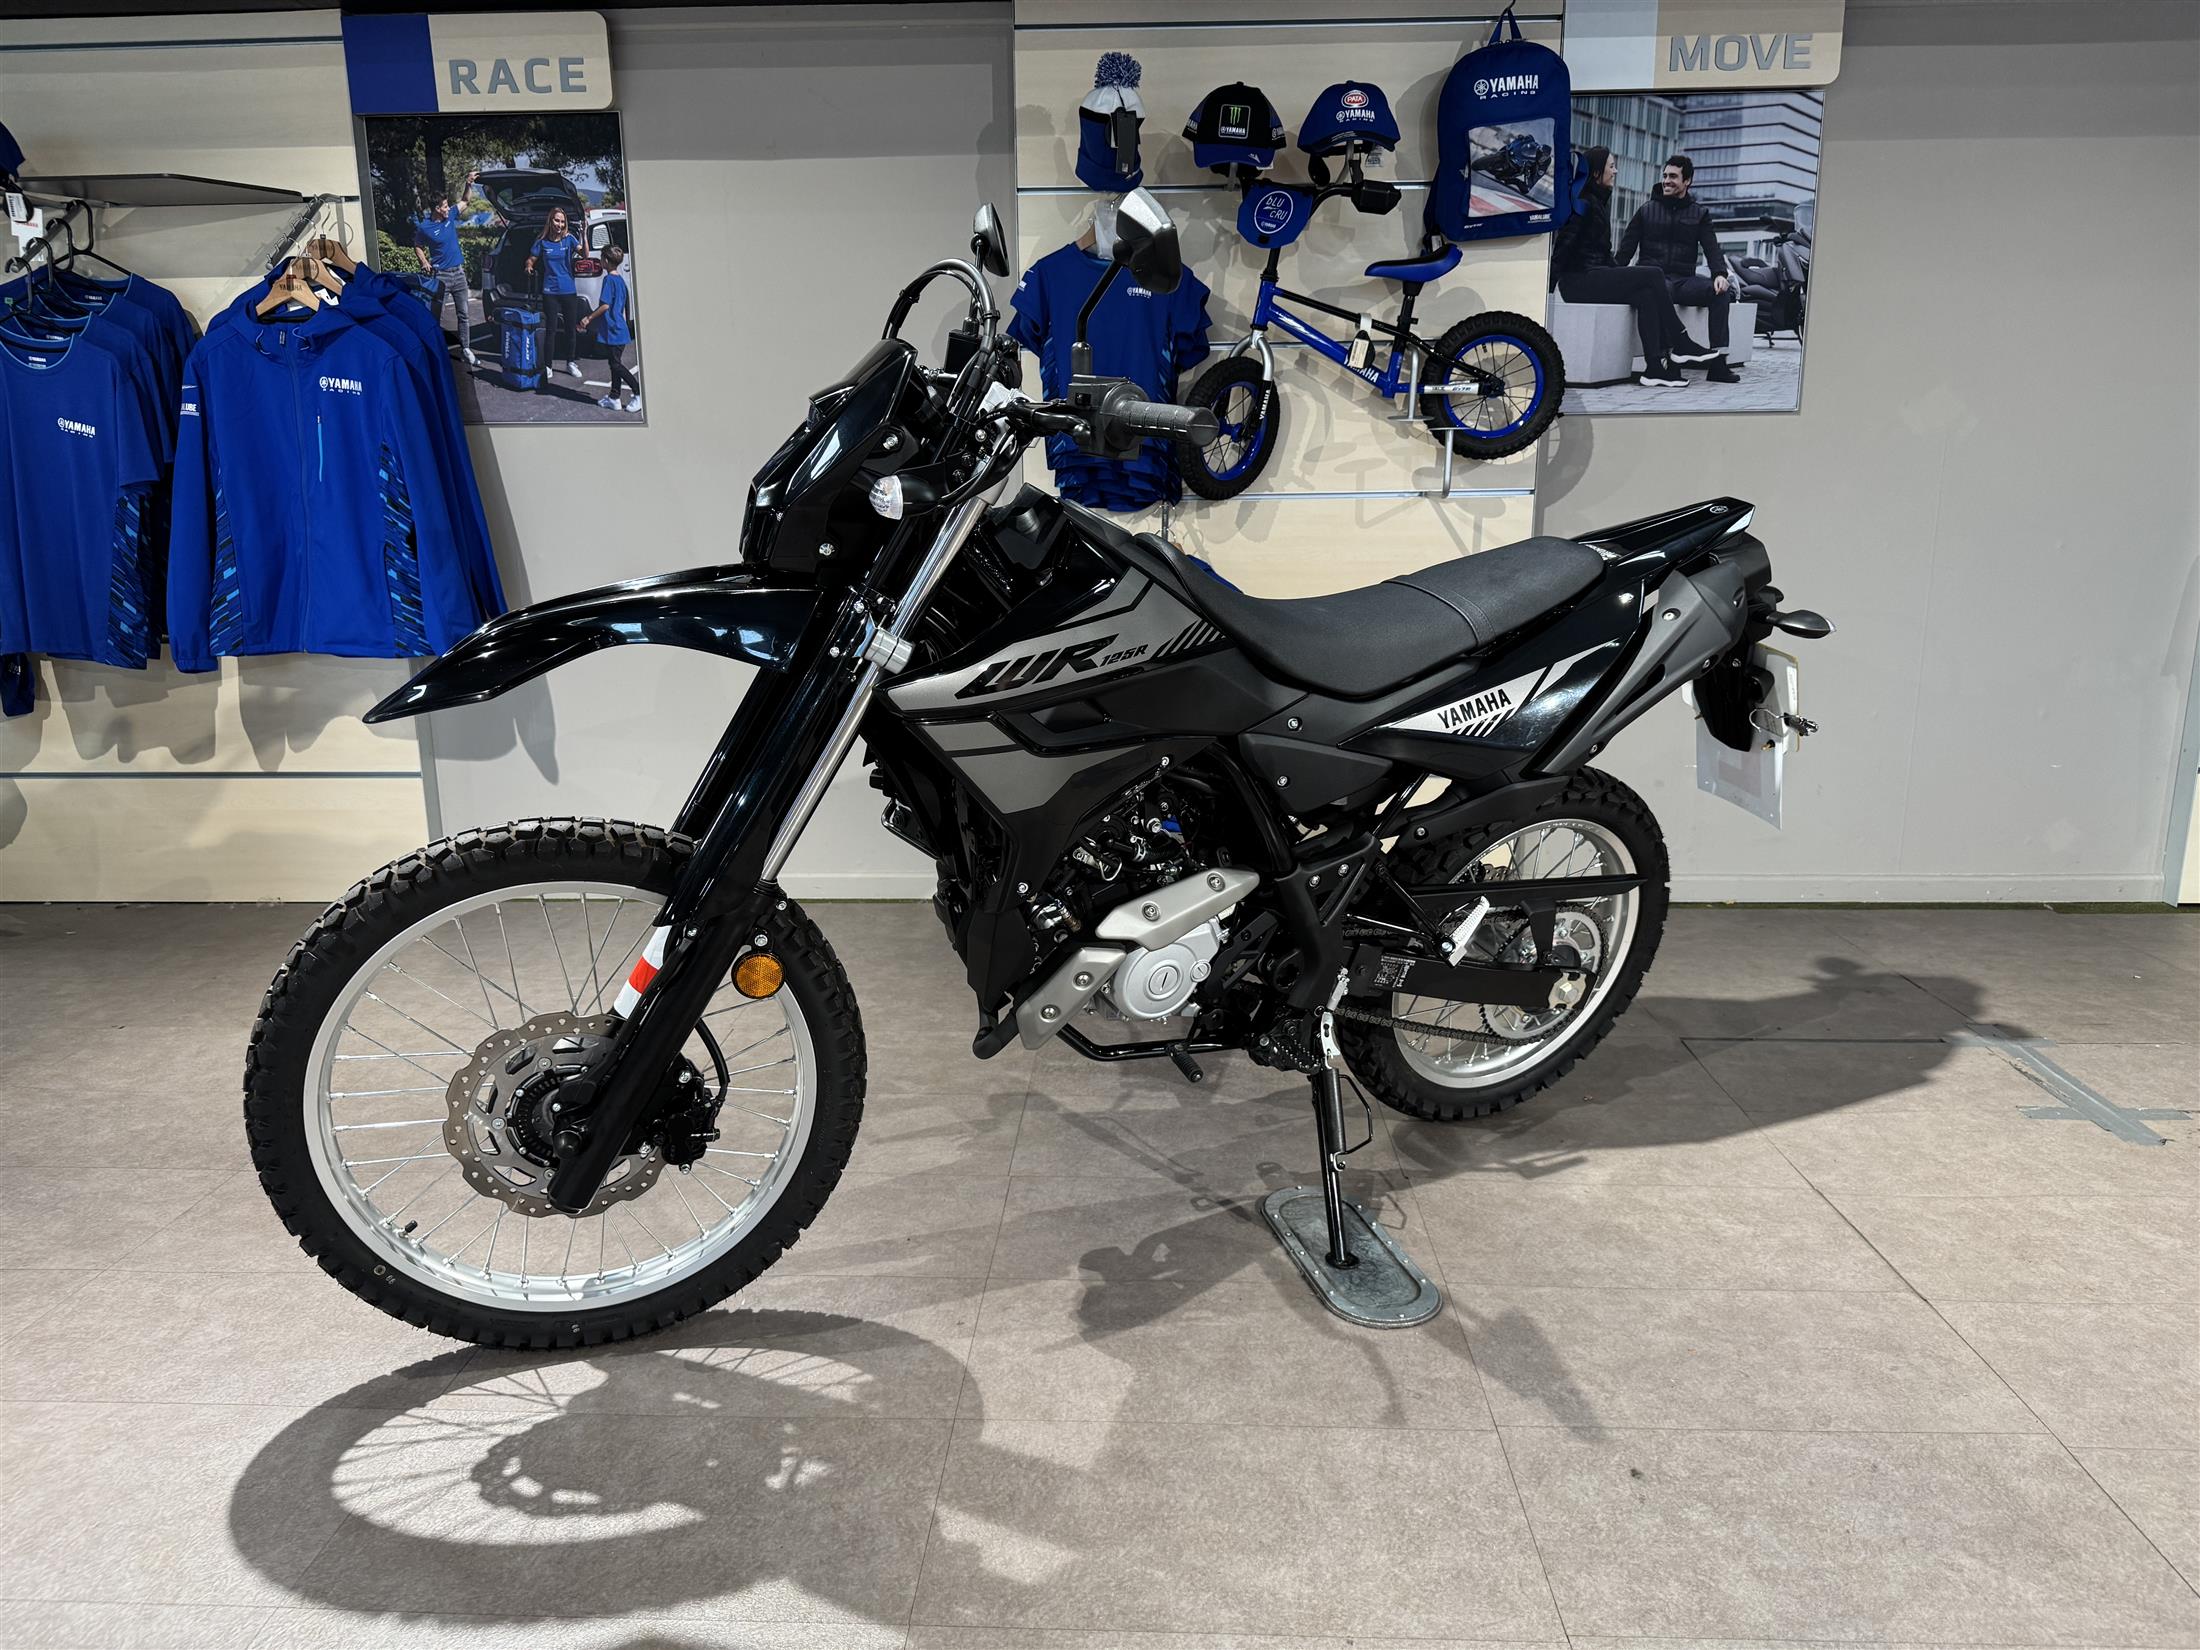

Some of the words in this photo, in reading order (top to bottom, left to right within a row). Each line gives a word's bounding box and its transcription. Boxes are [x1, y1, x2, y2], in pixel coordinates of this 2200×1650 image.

[1668, 33, 1813, 72] MOVE
[448, 56, 587, 95] RACE
[1489, 74, 1539, 93] YAMAHA
[1347, 94, 1364, 105] PATA
[1344, 109, 1376, 120] YAMAHA
[1226, 126, 1246, 134] YAMAHA
[328, 377, 363, 393] YAMAHA
[1259, 389, 1271, 420] YAMAHA
[64, 419, 96, 436] YAMAHA
[954, 633, 1120, 700] WR
[1099, 643, 1149, 668] 125R
[1437, 688, 1512, 729] YAMAHA
